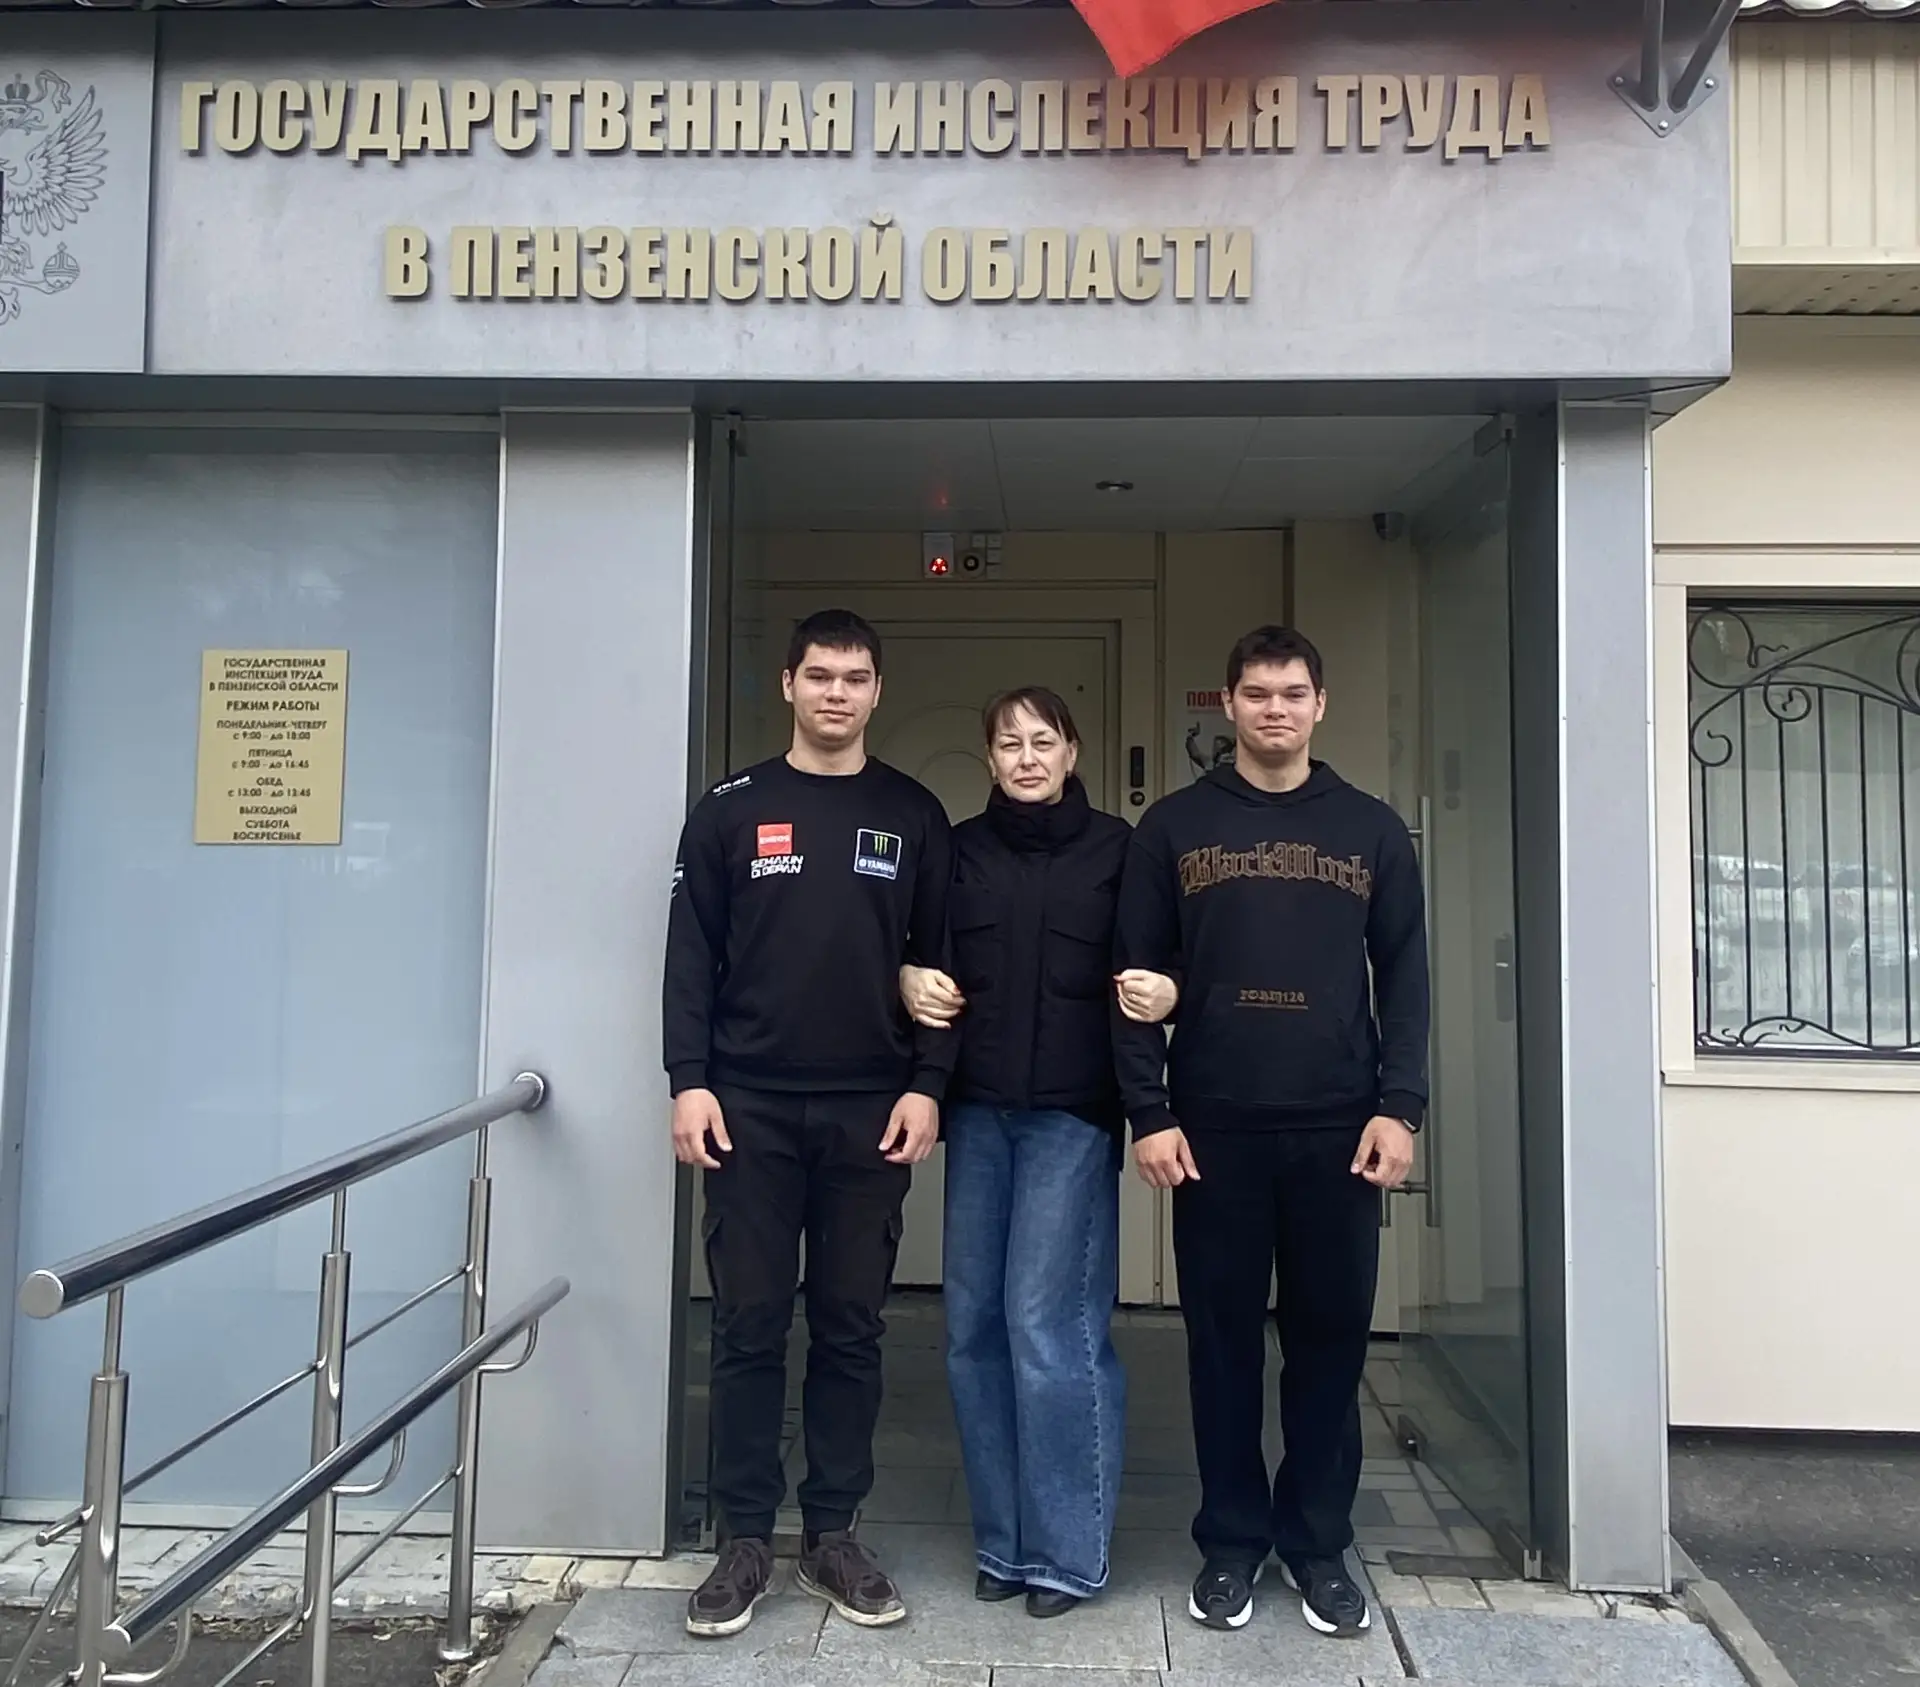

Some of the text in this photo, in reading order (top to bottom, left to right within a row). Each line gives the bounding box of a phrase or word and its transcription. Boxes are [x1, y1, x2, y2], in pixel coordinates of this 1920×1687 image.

[180, 74, 1551, 161] ГОСУДАРСТВЕННАЯ ИНСПЕКЦИЯ ТРУДА
[386, 210, 1253, 301] В ПЕНЗЕНСКОЙ ОБЛАСТИ
[224, 658, 326, 669] ГОСУДАРСТВЕННАЯ
[225, 670, 323, 680] ИНСПЕКЦИЯ ТРУДА
[209, 680, 338, 691] В ПЕНЗЕНСКОЙ ОБЛАСТИ
[226, 701, 320, 711] РЕЖИМ РАБОТЫ
[242, 731, 261, 740] 9:00
[286, 731, 310, 740] 18:00
[248, 749, 292, 758] ПЯТНИЦА
[241, 760, 260, 769] 9:00
[256, 777, 283, 787] ОБЕД
[239, 804, 297, 814] ВЫХОДНОЙ
[245, 820, 290, 829] СУББОТА
[233, 831, 302, 841] ВОСКРЕСЕНЬЕ
